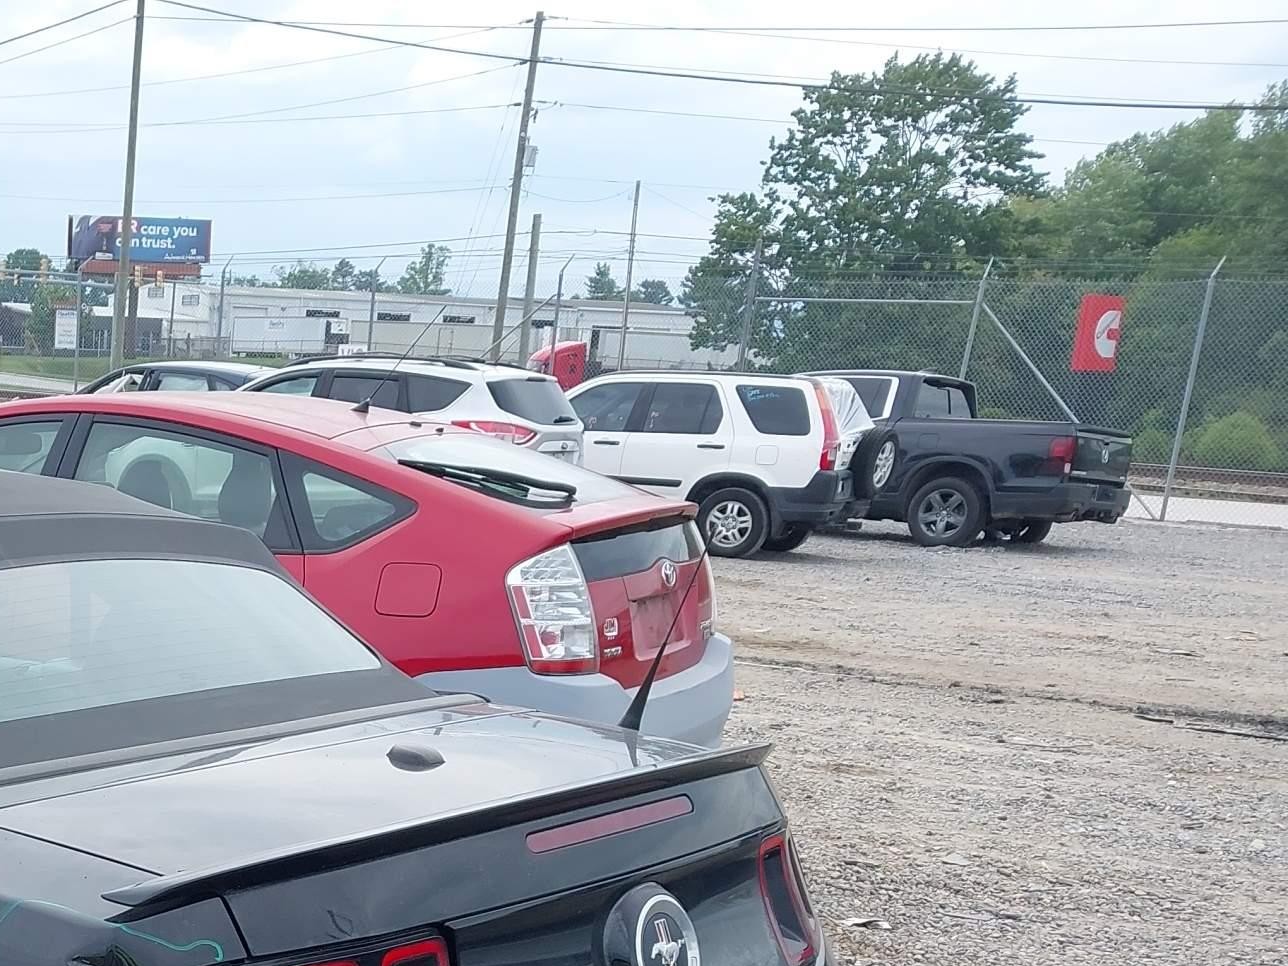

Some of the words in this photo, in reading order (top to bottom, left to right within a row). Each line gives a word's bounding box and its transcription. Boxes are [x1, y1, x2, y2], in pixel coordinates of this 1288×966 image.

[140, 225, 170, 235] care
[173, 226, 198, 239] you
[115, 237, 140, 248] cn
[141, 237, 176, 249] trust.
